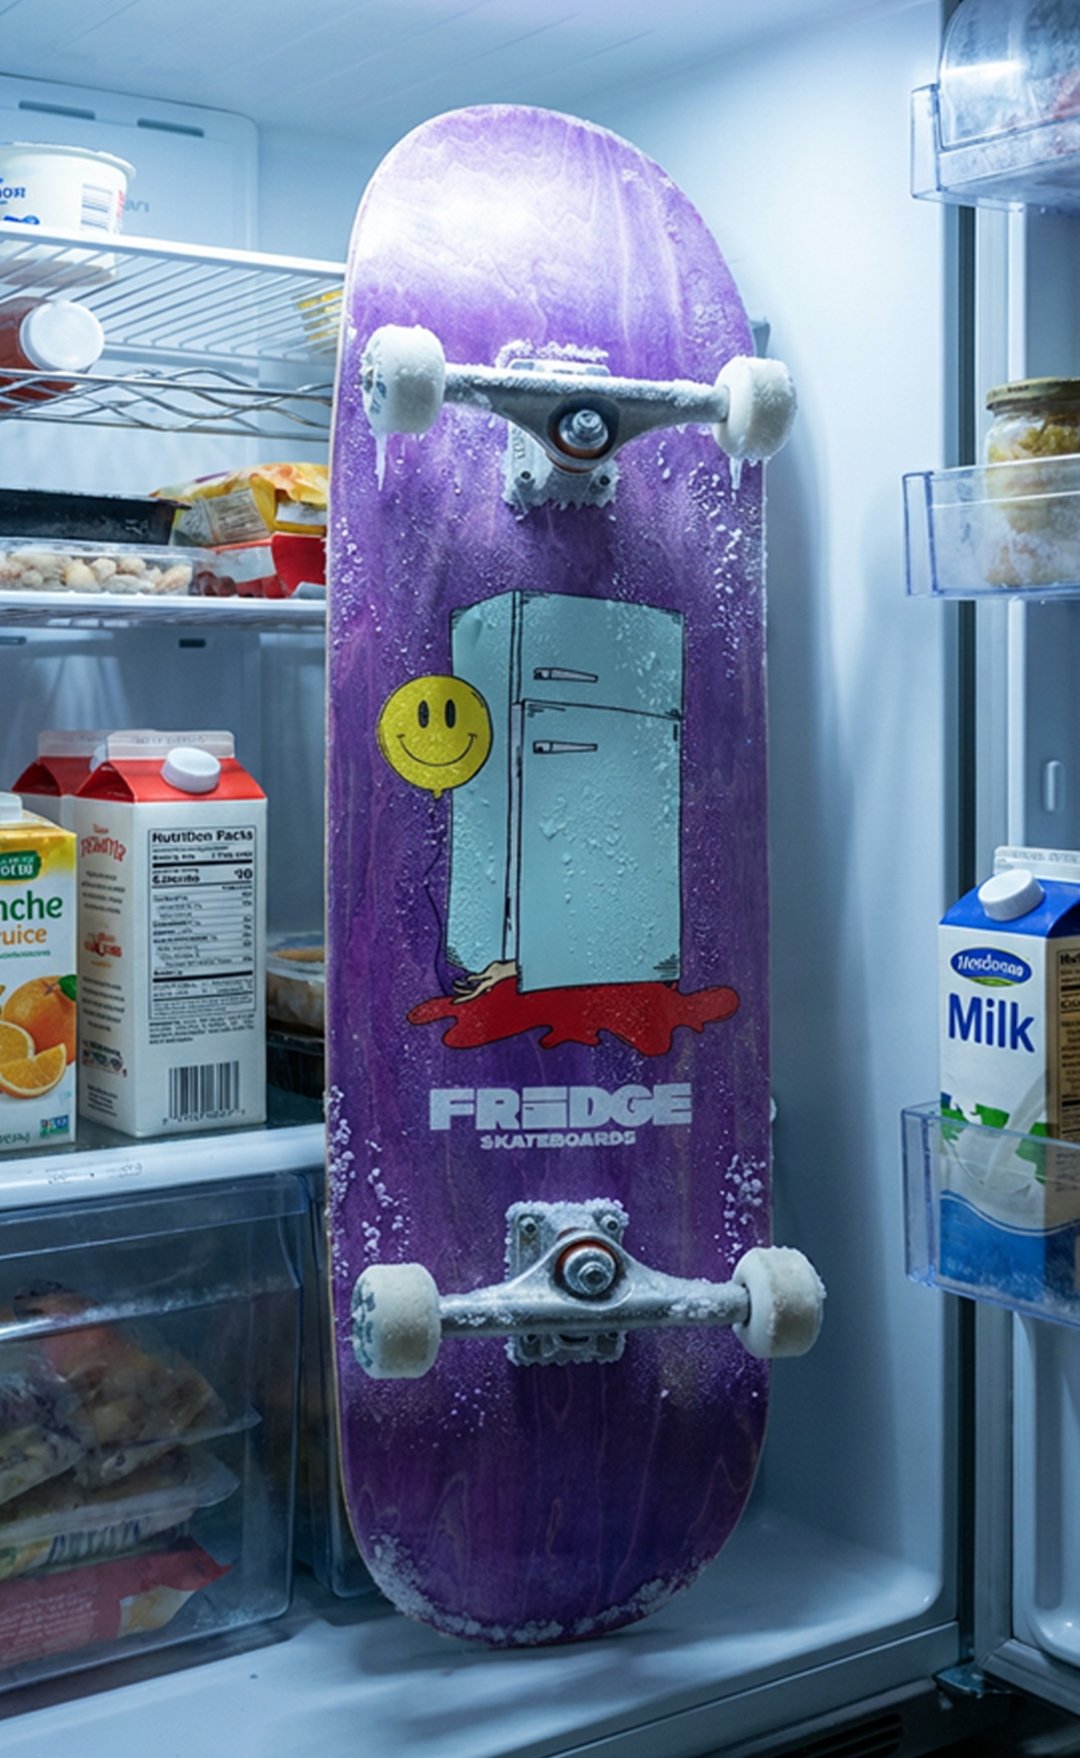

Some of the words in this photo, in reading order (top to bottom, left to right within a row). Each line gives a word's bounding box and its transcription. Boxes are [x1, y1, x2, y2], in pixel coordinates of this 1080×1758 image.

[0, 924, 47, 946] uice
[948, 993, 1036, 1054] Milk
[429, 1083, 693, 1130] FRIDGE
[480, 1130, 637, 1150] SKATEBOARDS
